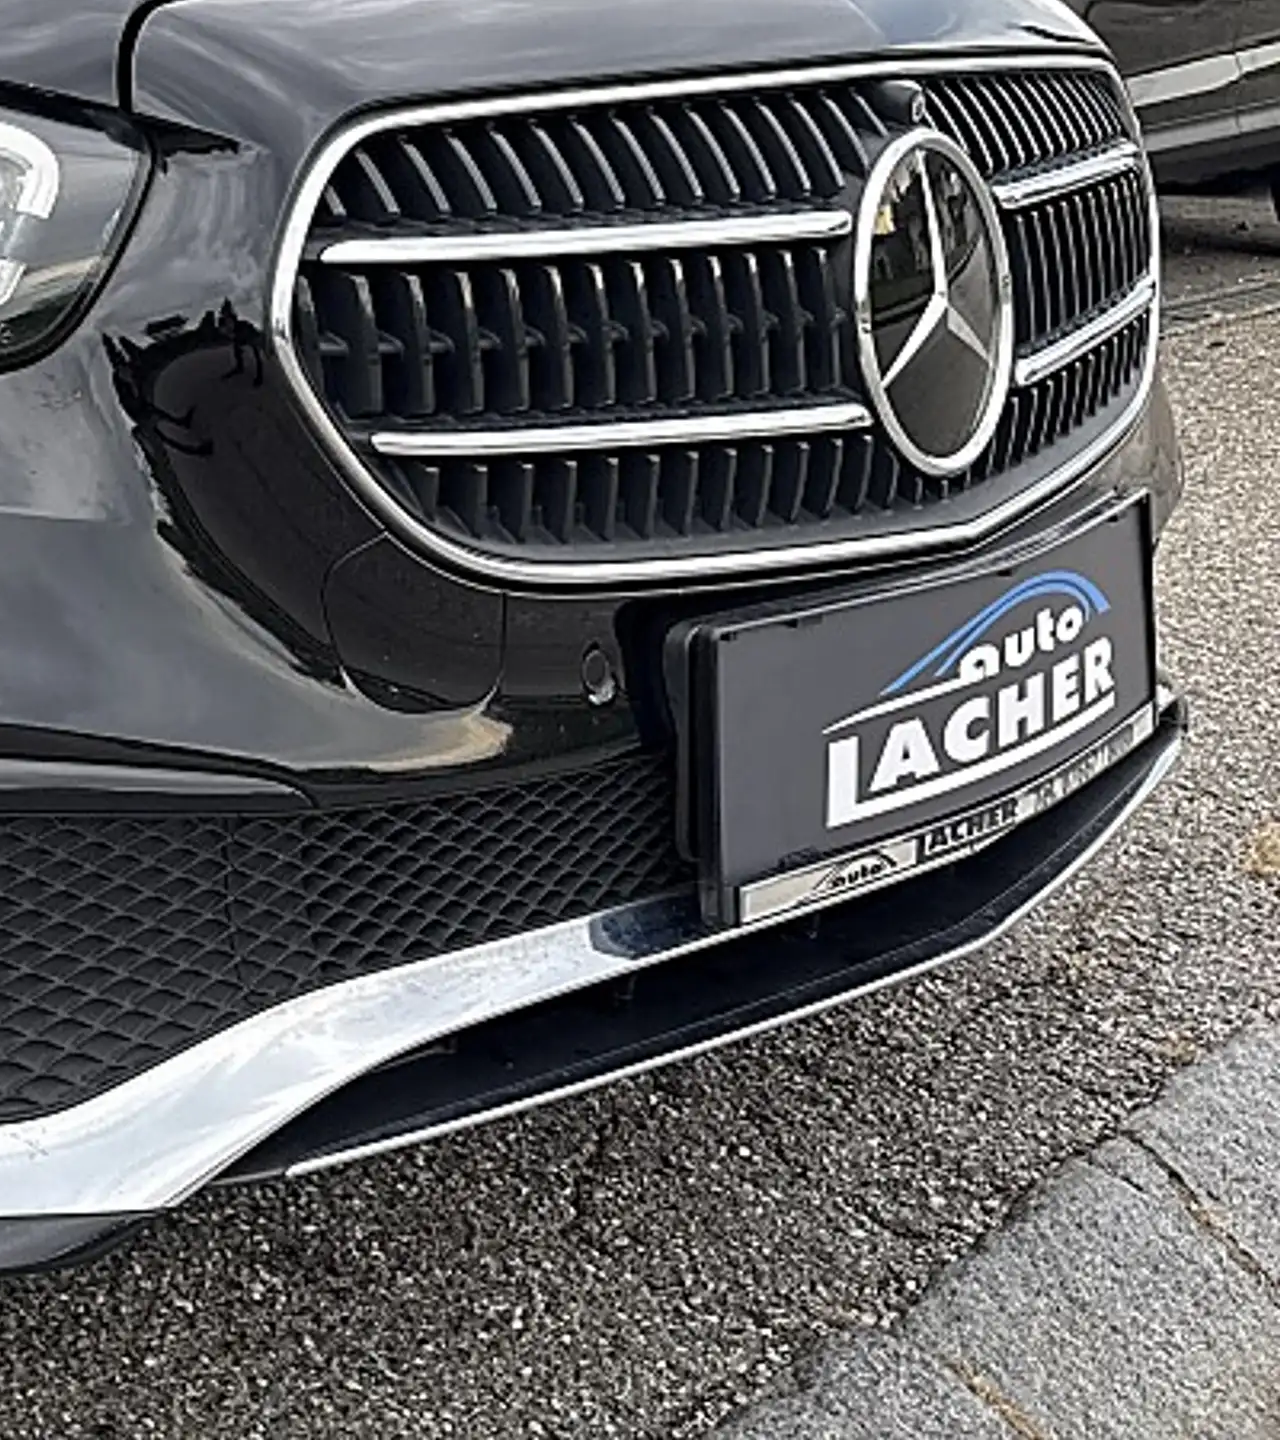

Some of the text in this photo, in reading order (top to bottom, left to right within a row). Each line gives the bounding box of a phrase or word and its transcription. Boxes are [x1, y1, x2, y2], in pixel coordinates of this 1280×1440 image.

[959, 605, 1083, 684] auto
[826, 636, 1116, 829] LACHER
[916, 796, 1019, 864] LACHER
